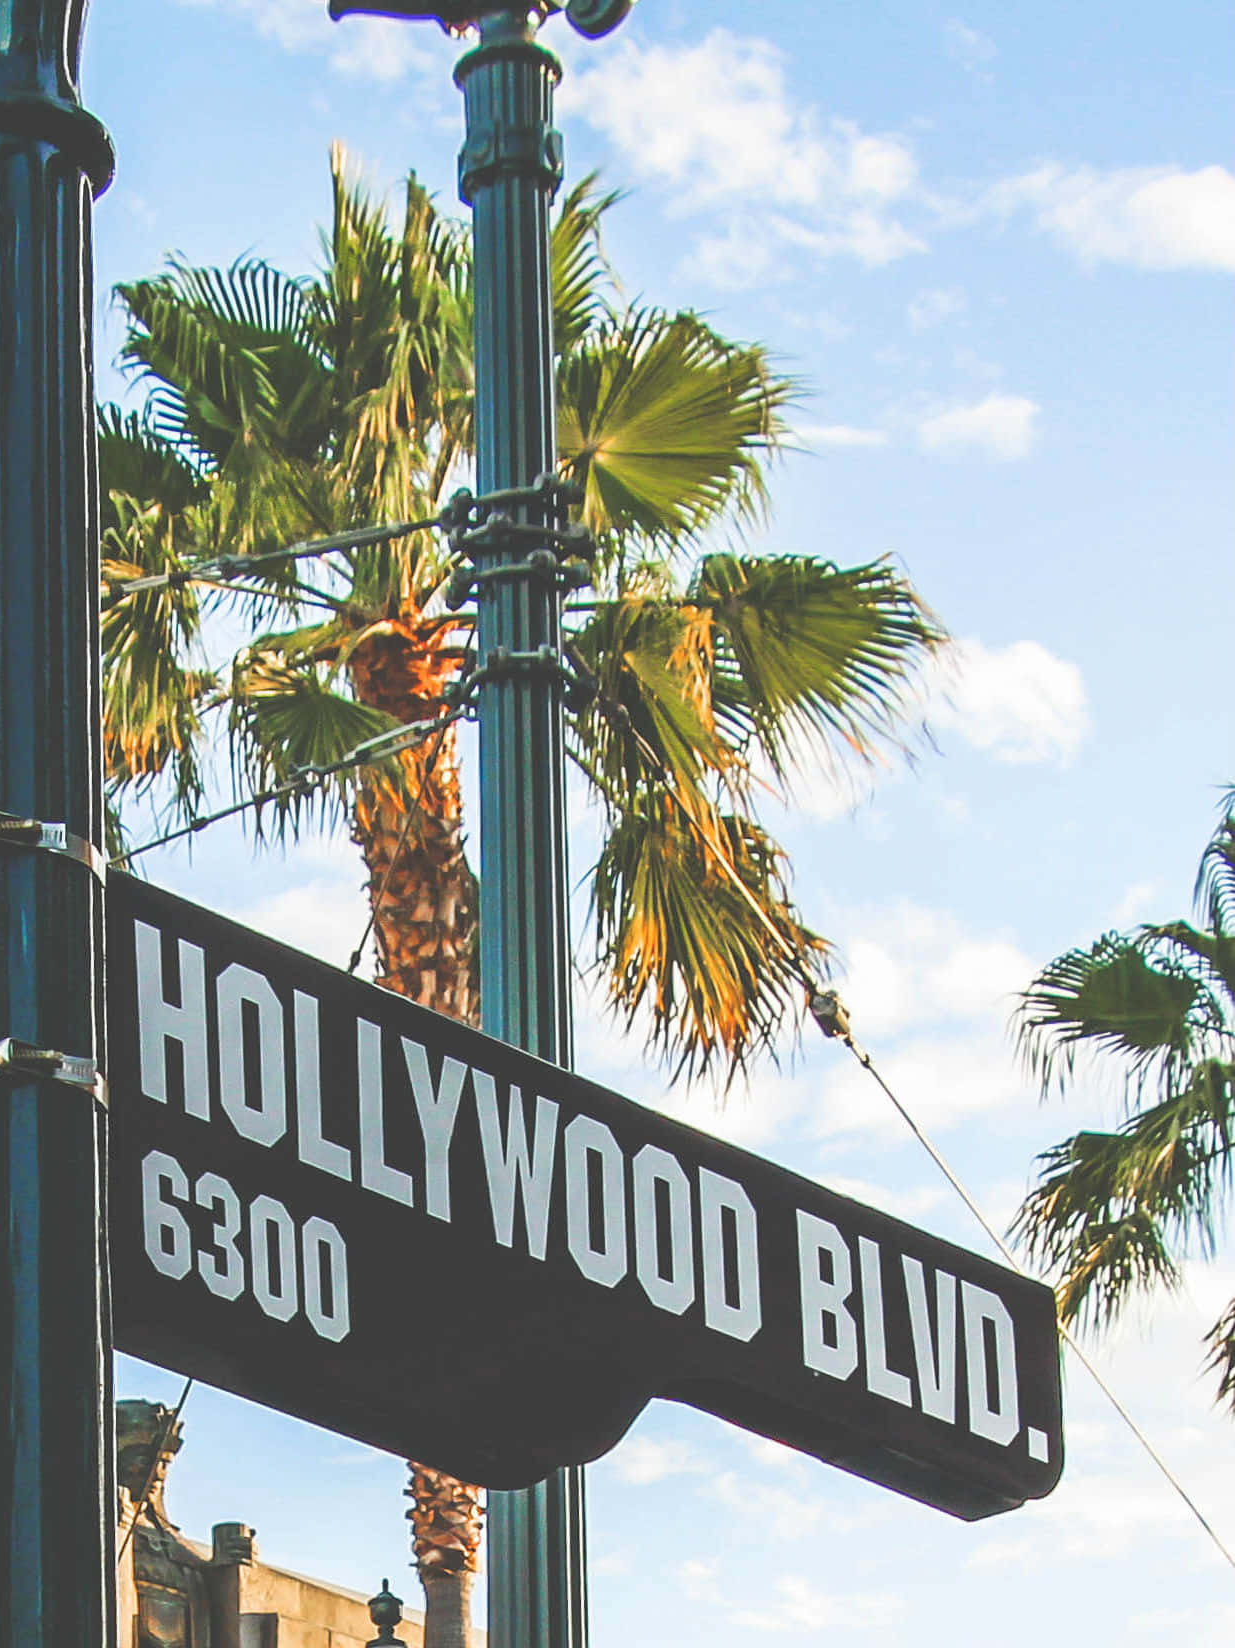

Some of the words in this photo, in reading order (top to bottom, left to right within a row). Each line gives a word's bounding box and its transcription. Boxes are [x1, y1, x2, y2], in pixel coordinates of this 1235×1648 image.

[133, 918, 762, 1343] HOLLYWOOD
[795, 1208, 1049, 1464] BLVD.
[141, 1149, 351, 1343] 6300
